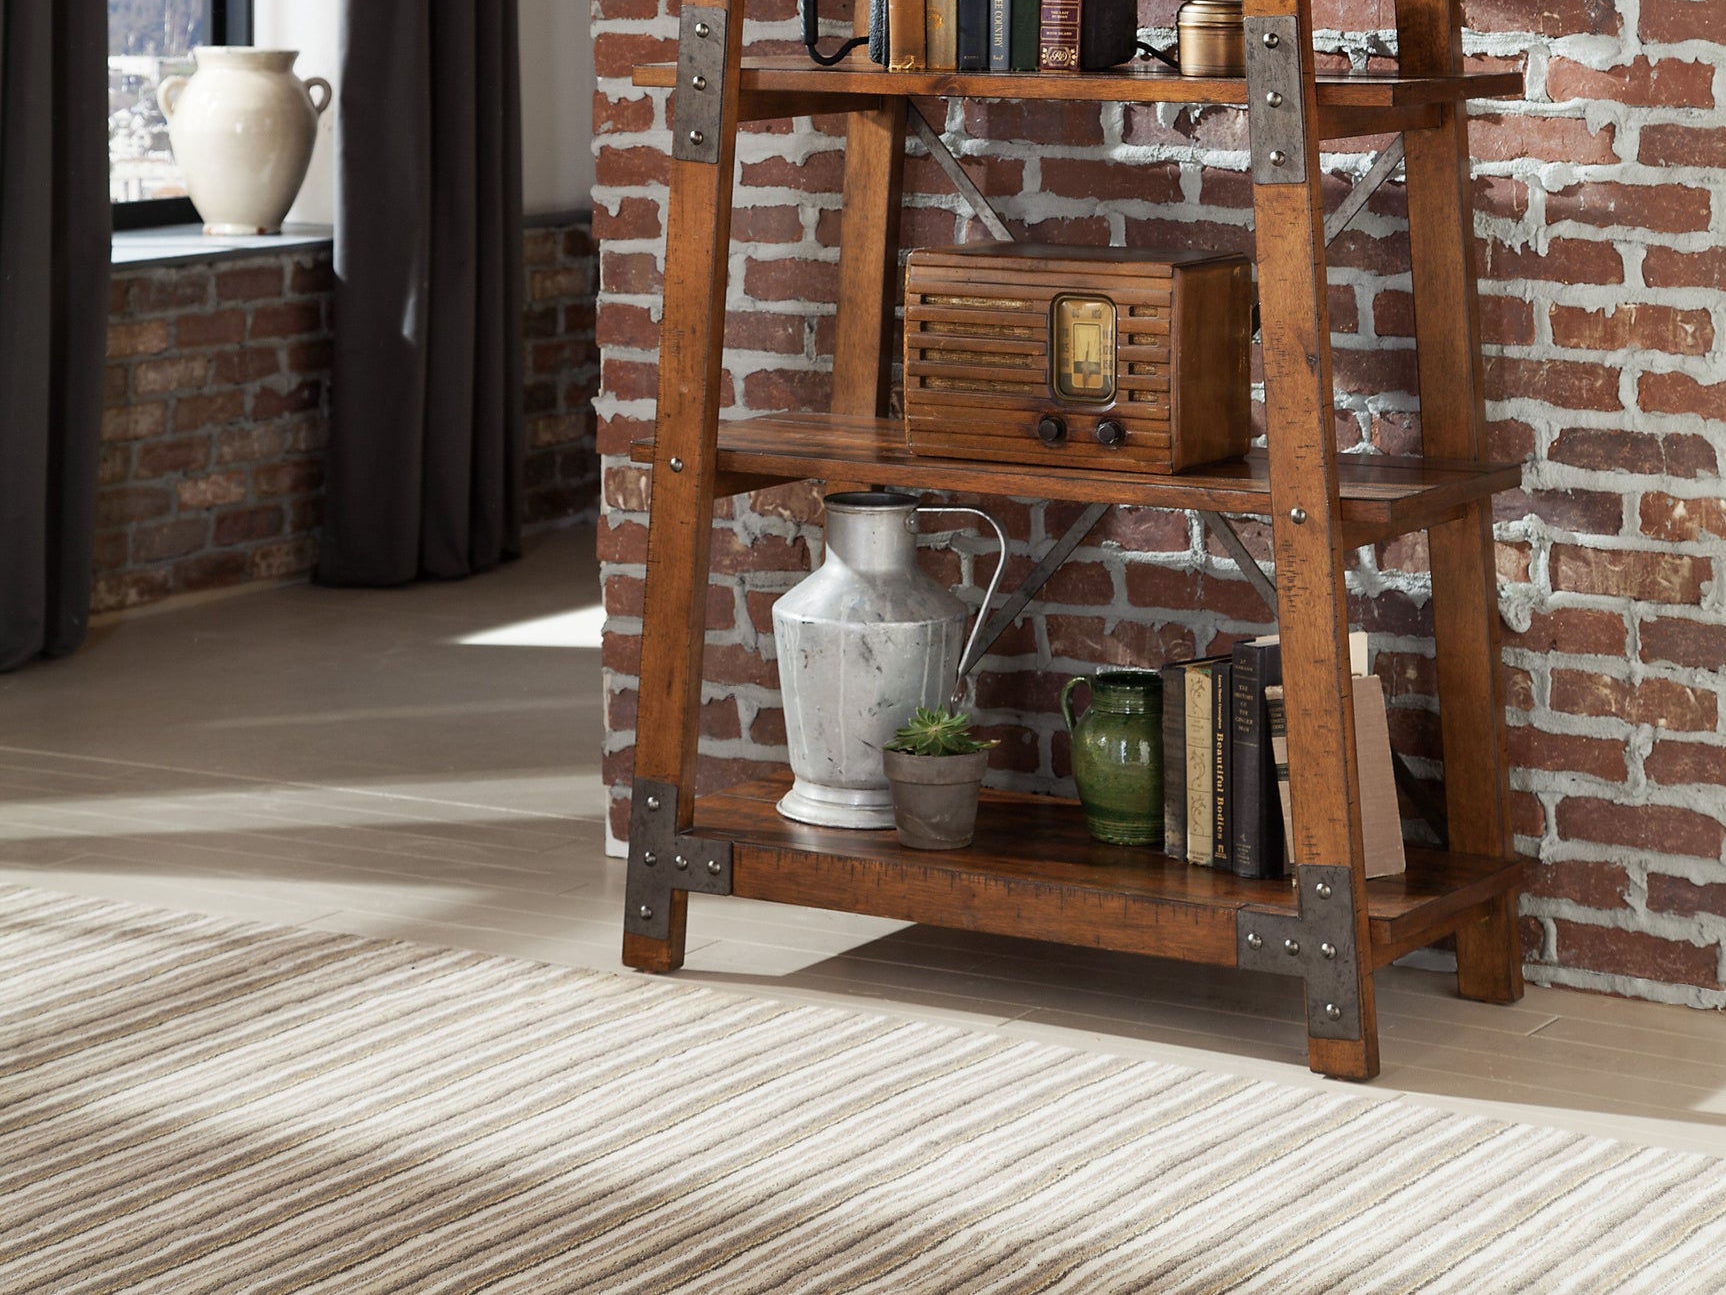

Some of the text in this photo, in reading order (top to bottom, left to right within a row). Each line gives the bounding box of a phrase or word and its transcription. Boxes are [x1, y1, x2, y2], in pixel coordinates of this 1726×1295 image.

[994, 10, 1003, 48] COUNTRY
[1216, 733, 1225, 840] Beautiful Bodies
